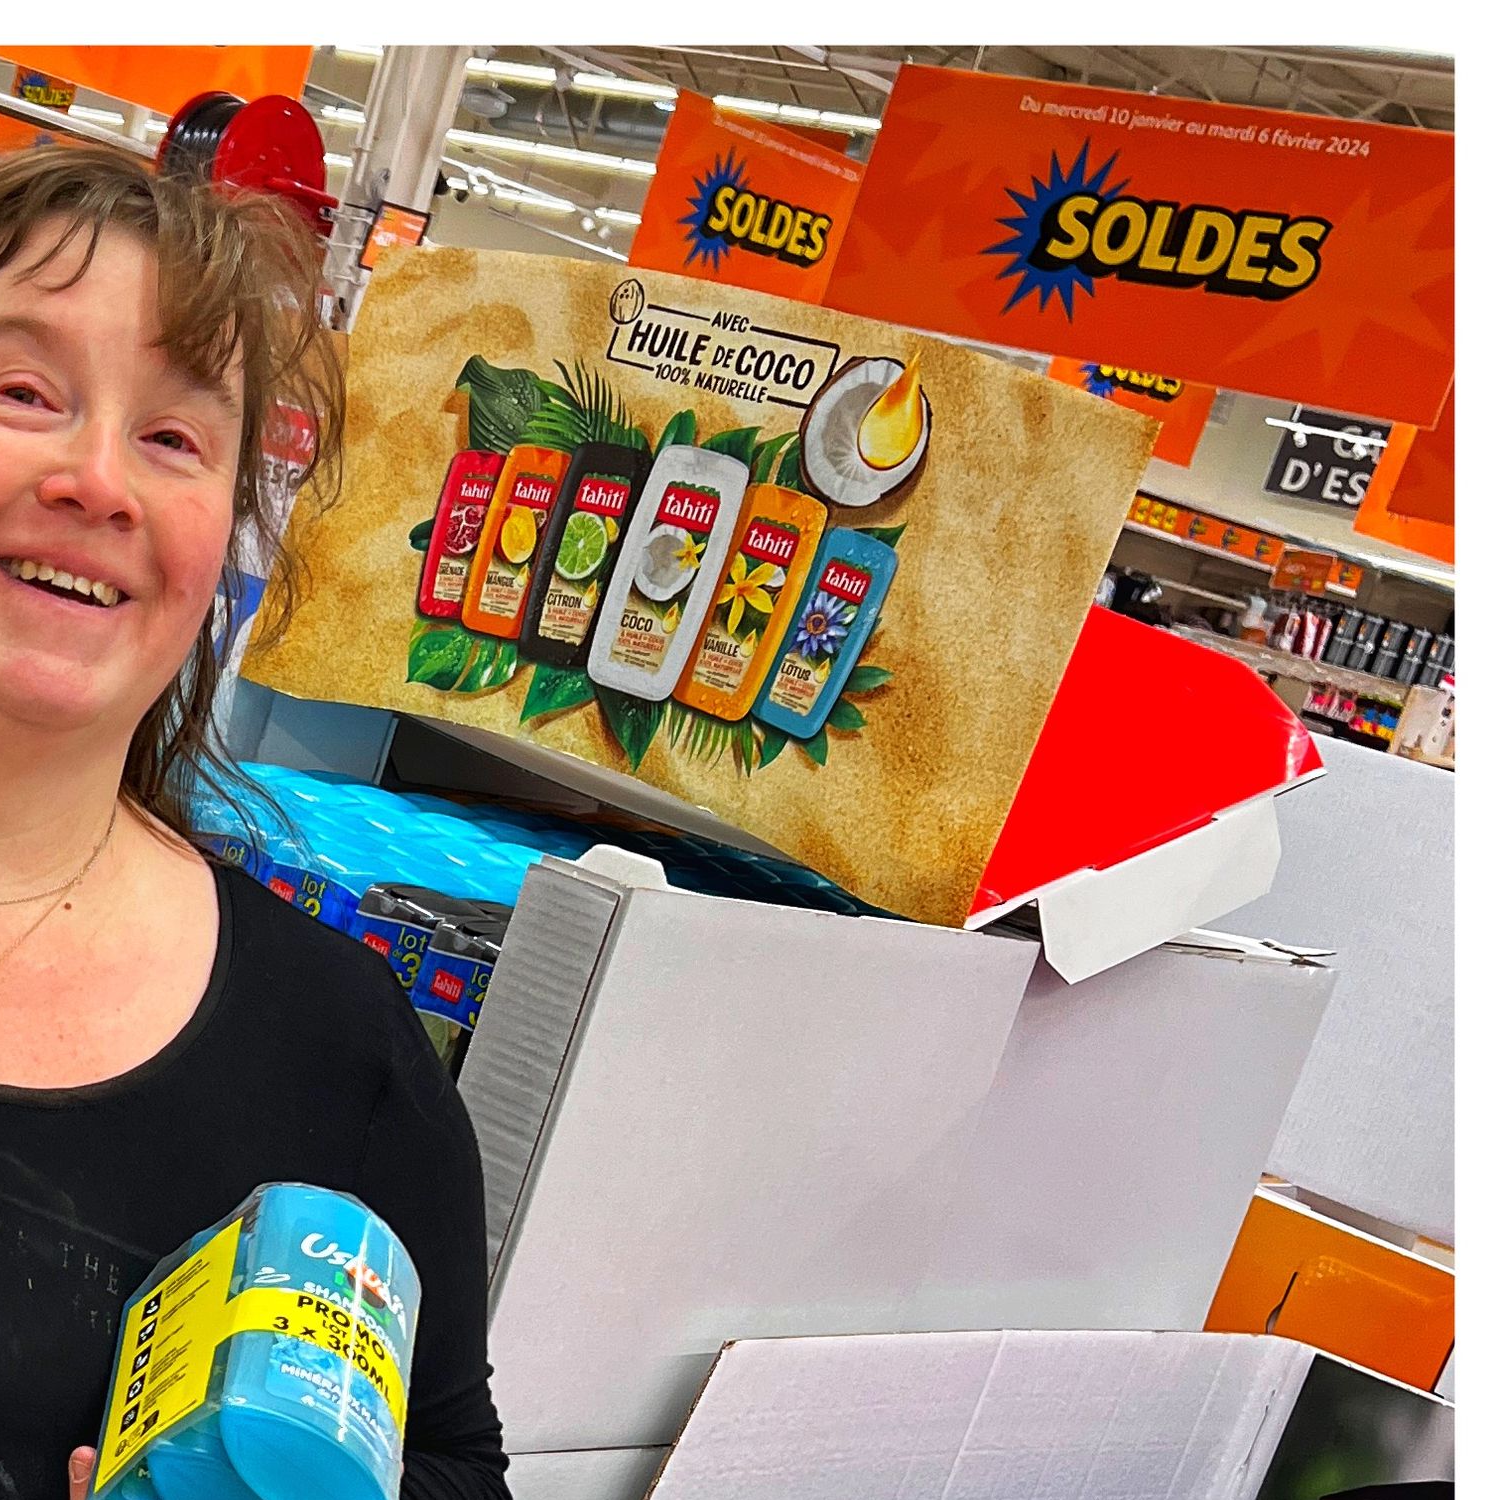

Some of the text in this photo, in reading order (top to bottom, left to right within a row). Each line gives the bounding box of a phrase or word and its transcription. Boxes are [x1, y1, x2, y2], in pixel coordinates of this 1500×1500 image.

[1020, 96, 1371, 157] Du mercredi 10 janvier au mardi 6 février 2024
[708, 186, 832, 260] SOLDES
[1049, 195, 1331, 292] SOLDES
[711, 312, 750, 333] AVEC
[628, 325, 708, 367] HUILE
[734, 344, 815, 388] COCO
[655, 364, 767, 404] 100% NATURELLE
[515, 482, 551, 503] tahiti
[582, 485, 623, 509] tahiti
[486, 572, 515, 586] MANGUE
[826, 567, 865, 597] tahiti
[547, 593, 582, 608] CITRON
[622, 615, 652, 632] COCO
[704, 638, 740, 657] VANILLE
[781, 662, 811, 680] LOTUS
[302, 873, 326, 898] lot
[398, 928, 427, 951] lot
[298, 1294, 385, 1361] PROMO
